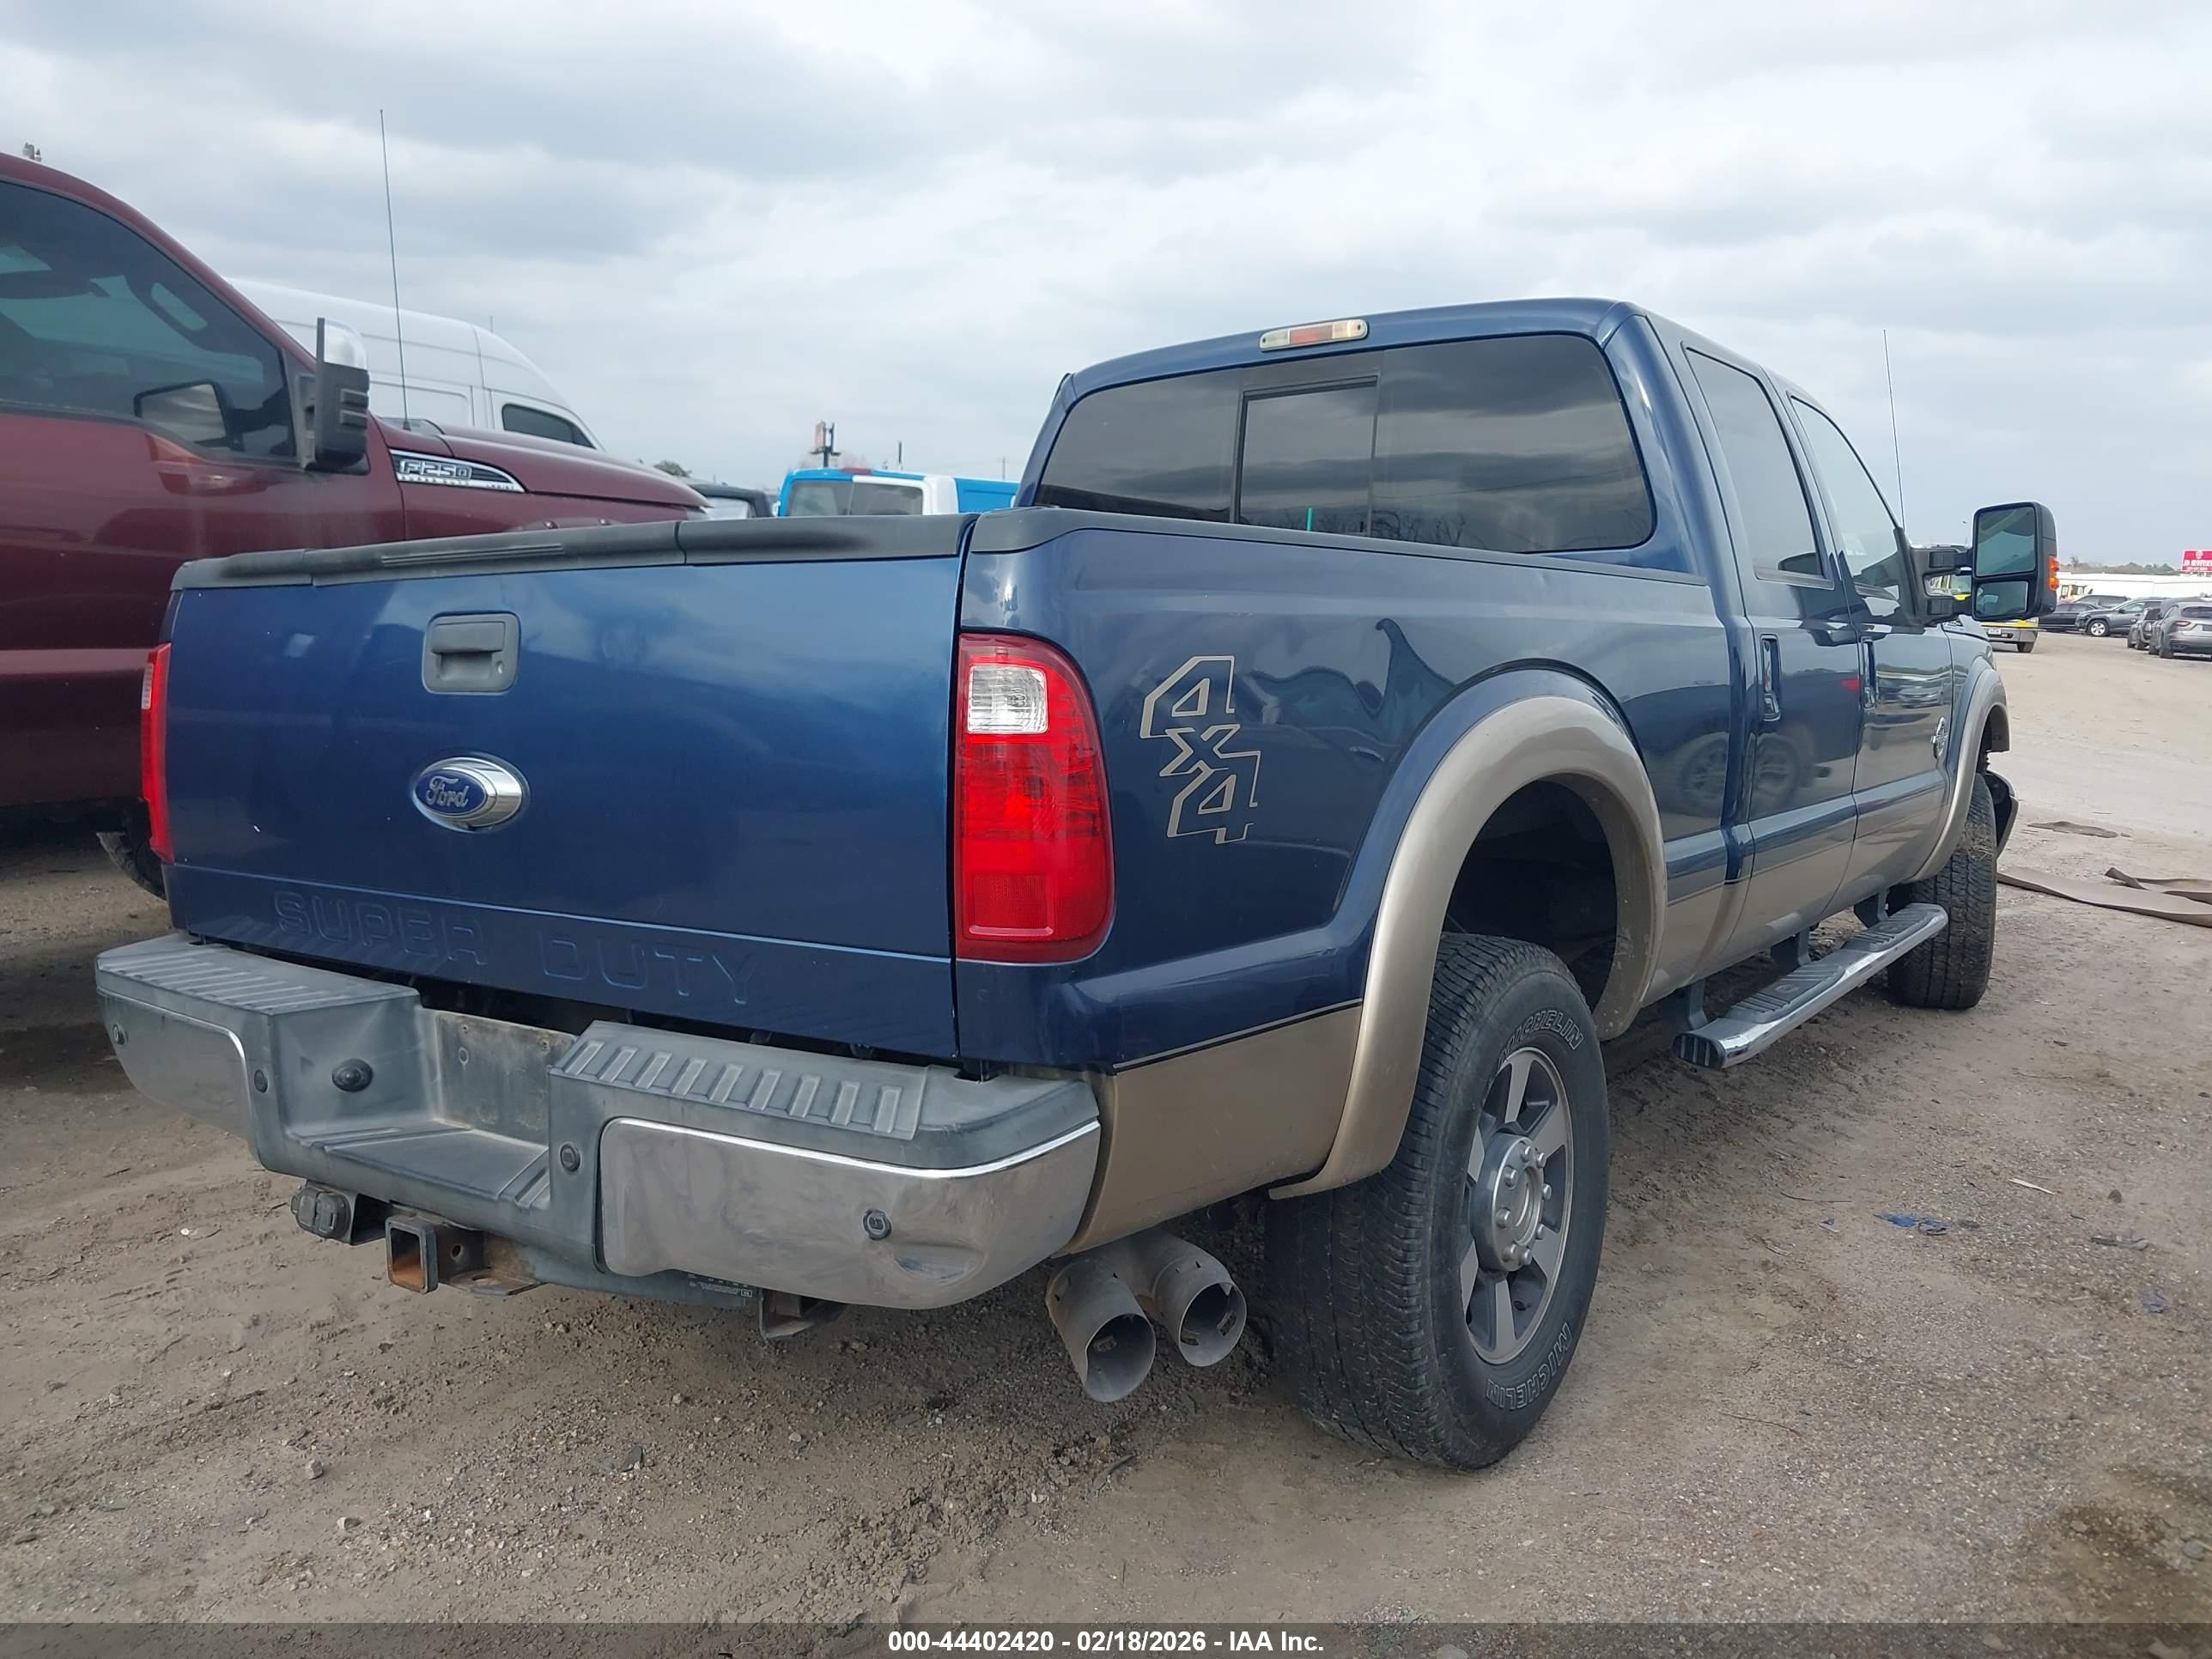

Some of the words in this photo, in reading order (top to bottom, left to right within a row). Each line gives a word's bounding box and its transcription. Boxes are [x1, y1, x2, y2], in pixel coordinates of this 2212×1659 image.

[425, 775, 470, 807] Ford
[274, 890, 488, 966] SUPER
[538, 926, 760, 1004] DUTY
[1497, 1010, 1584, 1067] MICHELIN
[1486, 1322, 1572, 1410] MICHELIN
